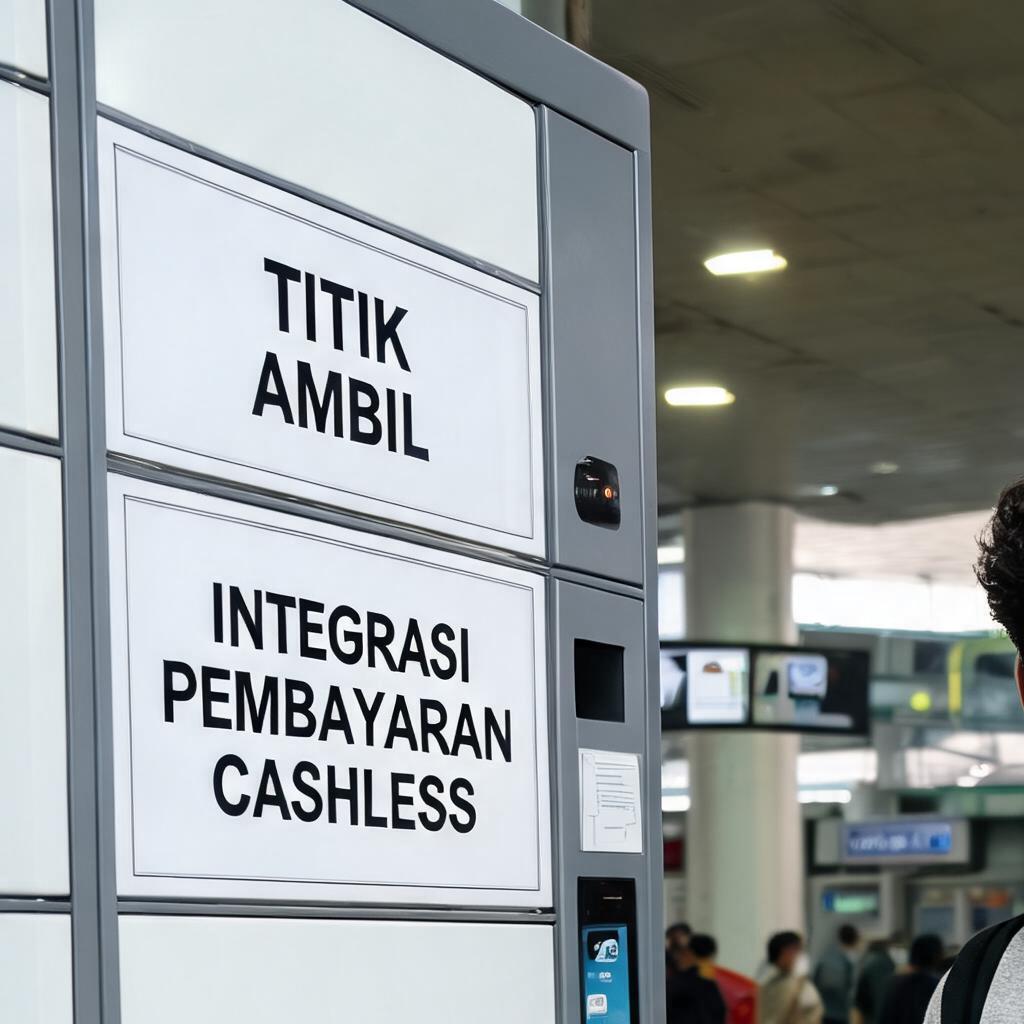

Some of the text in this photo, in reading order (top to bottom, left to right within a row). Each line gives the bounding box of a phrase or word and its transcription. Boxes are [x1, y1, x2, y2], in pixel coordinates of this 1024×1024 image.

[263, 257, 411, 373] TITIK
[251, 351, 430, 462] AMBIL
[213, 582, 469, 683] INTEGRASI
[162, 659, 512, 763] PEMBAYARAN
[212, 753, 477, 834] CASHLESS
